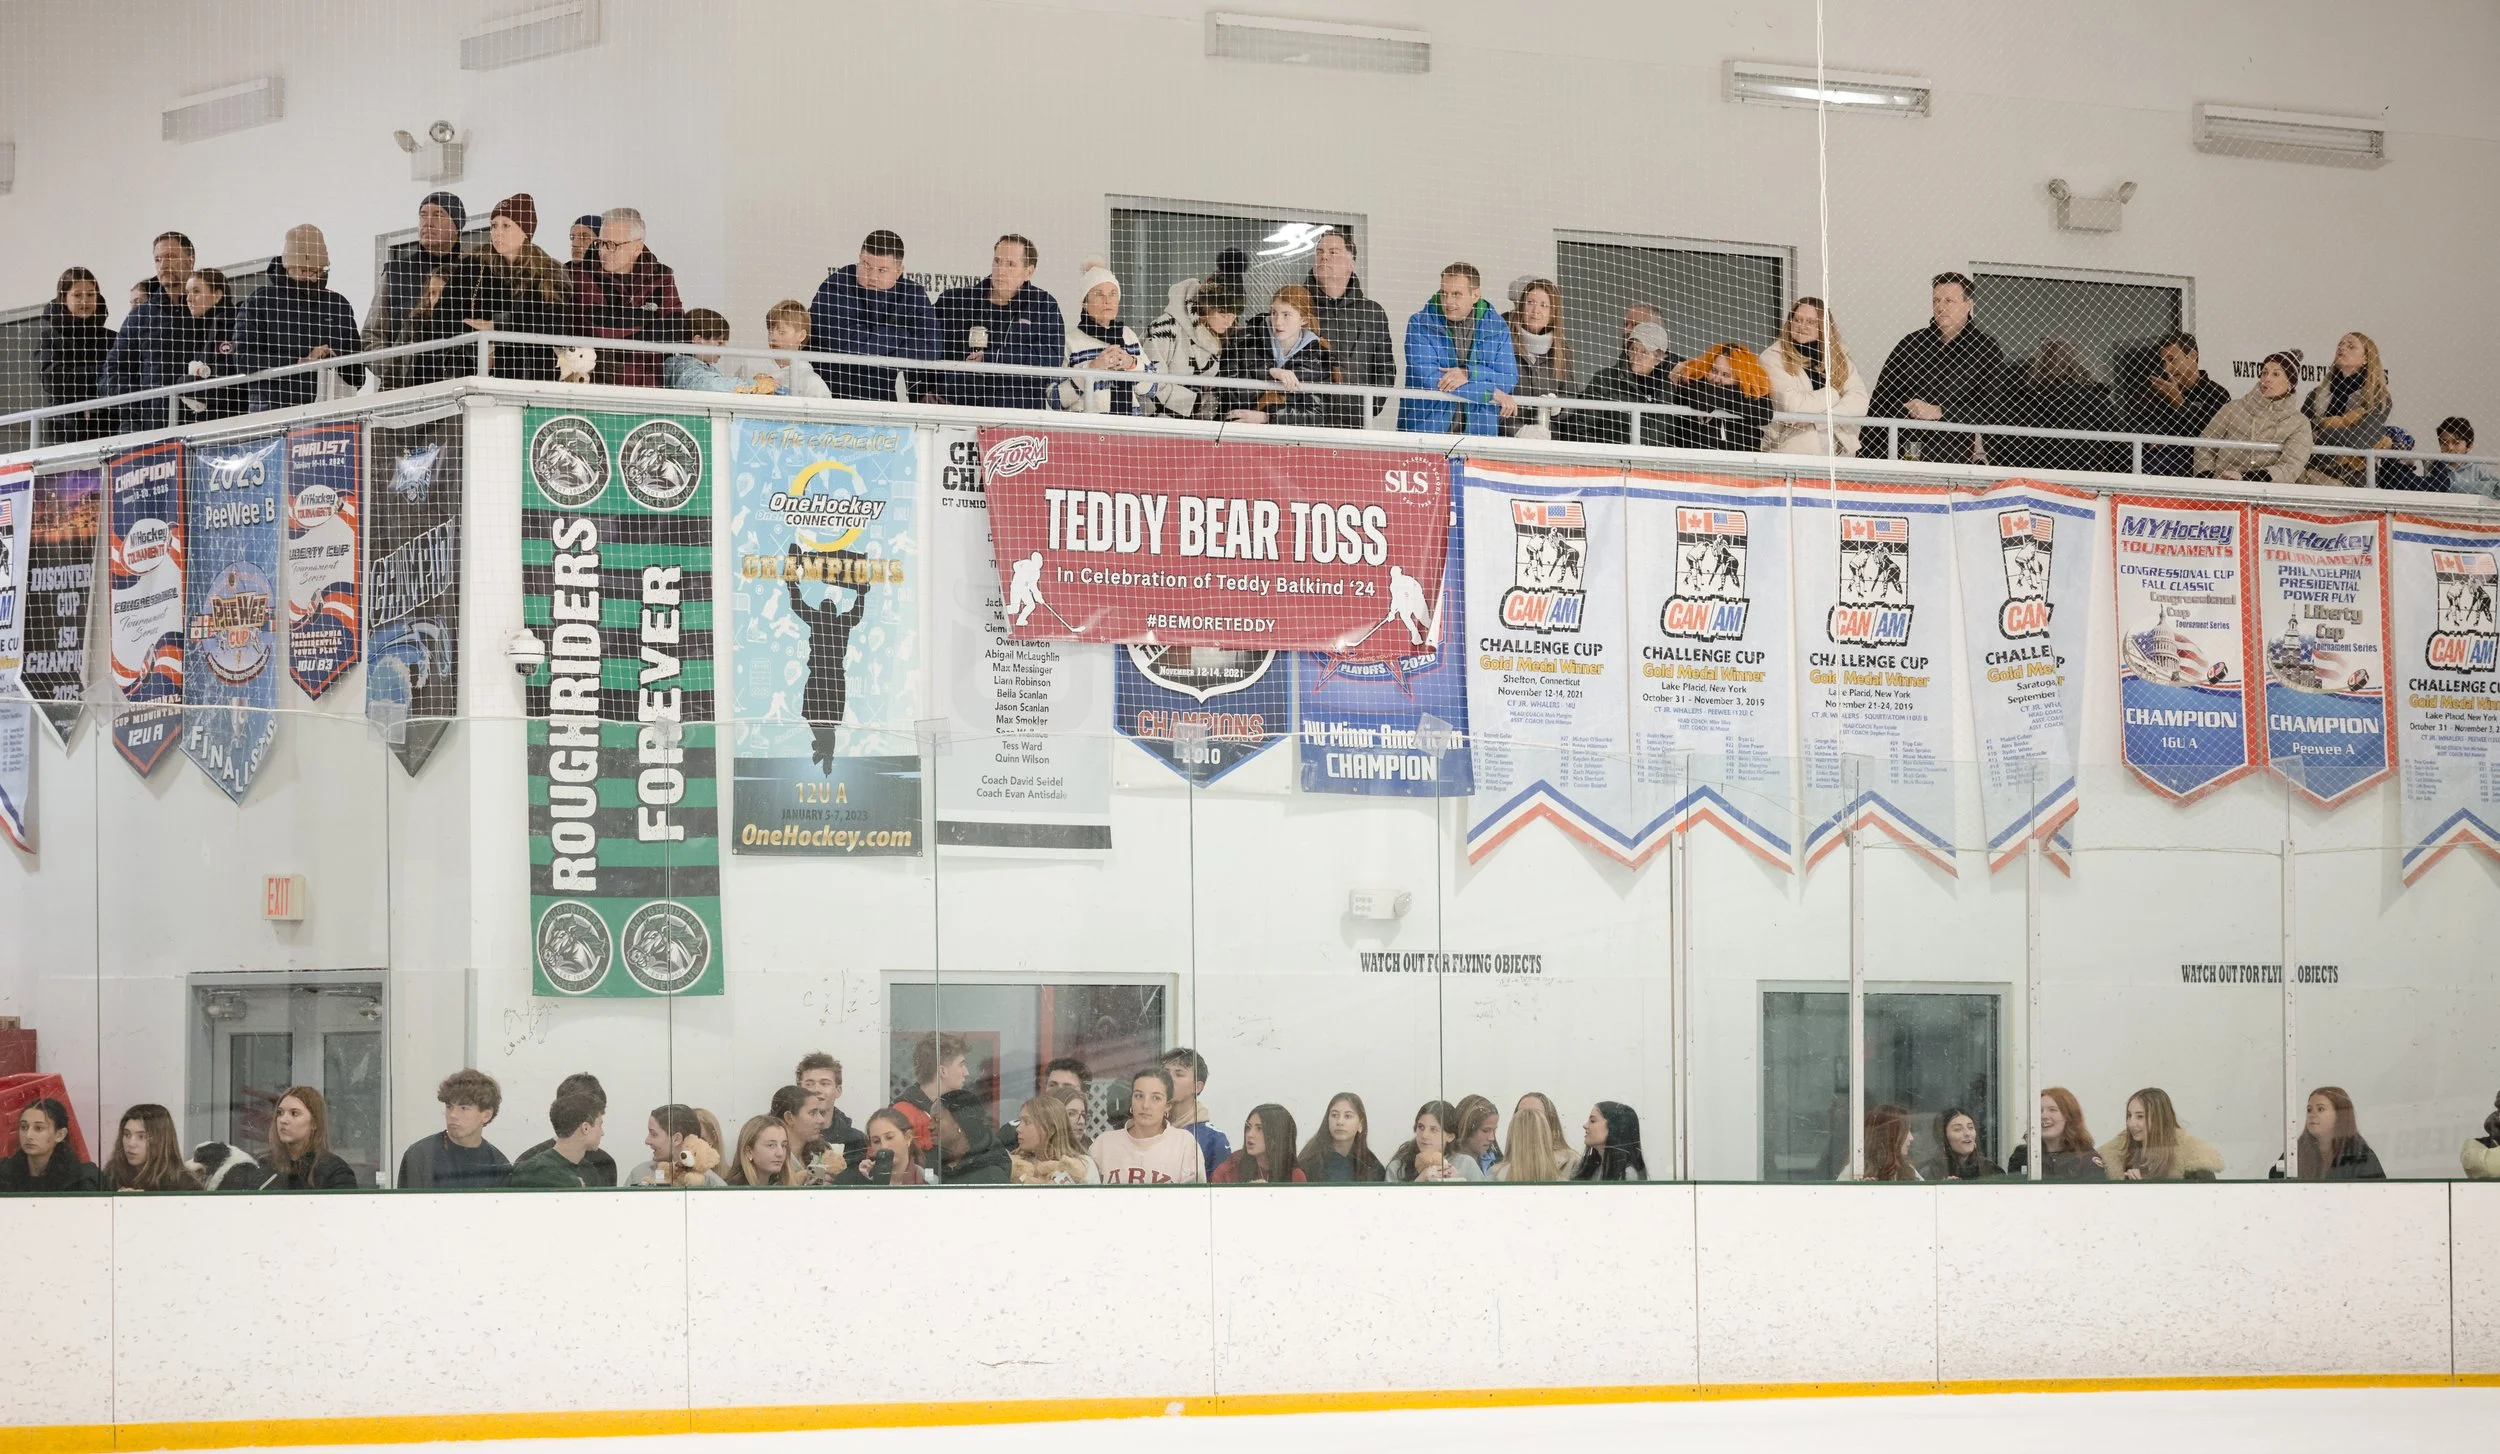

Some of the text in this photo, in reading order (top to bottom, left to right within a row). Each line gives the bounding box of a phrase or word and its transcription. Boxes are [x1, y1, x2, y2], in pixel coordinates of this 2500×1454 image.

[292, 440, 350, 458] FINALIST
[752, 429, 901, 452] LIVE EXPERIENCE!
[984, 436, 1047, 485] STORM
[115, 460, 176, 493] CHAMPION
[1385, 470, 1429, 494] SLS
[205, 497, 275, 530] PeeWee B
[769, 491, 886, 520] OneHockey
[785, 514, 869, 528] CONNECTICUT
[1045, 488, 1388, 566] TEDDY BEAR TOSS
[2121, 516, 2234, 545] MYHockey
[2264, 525, 2375, 555] MYHockey
[289, 543, 350, 561] LIBERTY CUP
[2121, 540, 2234, 558] TOURNAMENTS
[2264, 549, 2374, 566] TOURNAMENTS
[742, 555, 904, 584] CHAMPIONS
[2120, 565, 2235, 579] CONGRESSIONAL CUP
[2278, 565, 2361, 579] PHILADELPHIA
[1057, 566, 1344, 596] In Celebration of Teddy Balkind
[2142, 579, 2215, 591] FALL CLASSIC
[2279, 578, 2360, 591] PRESIDENTIAL
[57, 592, 80, 617] CUP
[2150, 591, 2237, 605] Congressional
[2284, 590, 2357, 603] POWER PLAY
[2166, 607, 2191, 619] Cup
[2304, 604, 2363, 625] Liberty
[1146, 613, 1276, 633] #BEMORETEDDY
[2175, 619, 2230, 630] Tournament Series
[57, 627, 77, 649] 150
[228, 629, 249, 648] CUP
[291, 629, 343, 640] PHILADELPHIA
[2316, 623, 2346, 642] Cup
[291, 639, 343, 649] PRESIDENTIAL
[995, 636, 1051, 648] Owen Lawton
[1480, 637, 1603, 656] CHALLENGE CUP
[2313, 641, 2378, 652] Tournament Series
[294, 646, 338, 657] POWER PLAY
[984, 650, 1060, 662] Abigail McLaughlin
[1643, 646, 1765, 665] CHALLENGE CUP
[992, 663, 1053, 676] Max Messinger
[1340, 662, 1387, 675] PLAYOFFS
[1402, 653, 1436, 671] 2020
[1480, 655, 1604, 675] Gold Medal Winner
[1901, 656, 1929, 670] CUP
[994, 676, 1051, 687] Liam Robinson
[1503, 674, 1580, 686] Shelton, Connecticut
[1643, 663, 1766, 683] Gold Medal Winner
[1844, 671, 1930, 688] Medal Winner
[1987, 666, 2023, 683] Gold
[53, 684, 79, 700] 2025
[1498, 687, 1583, 699] November 2021
[1661, 682, 1747, 694] Lake Placid, New York
[1850, 688, 1911, 699] Placid, New York
[2409, 678, 2486, 693] CHALLENGE
[997, 689, 1048, 700] Bella Scanlan
[1643, 693, 1765, 707] October 31 November 2019
[2008, 690, 2056, 704] September
[2409, 693, 2474, 710] Gold Medal
[550, 517, 600, 891] ROUGHRIDERS
[637, 566, 685, 842] FOREVER
[995, 702, 1050, 713] Jason Scanlan
[1895, 702, 1913, 711] 2019
[132, 707, 182, 725] MIDWINTER
[996, 715, 1048, 726] Max Smokler
[2125, 707, 2237, 729] CHAMPION
[2270, 713, 2379, 734] CHAMPION
[2425, 711, 2498, 722] Lake New York
[1138, 710, 1264, 742] CHAMPIONS
[2410, 722, 2488, 734] October November
[128, 723, 164, 747] 12U A
[1330, 721, 1376, 749] Minor
[2161, 736, 2198, 749] 16U A
[1002, 741, 1043, 751] Tess Ward
[2292, 742, 2355, 756] Peewee A
[190, 719, 275, 793] FINALISTS
[995, 753, 1050, 765] Quinn Wilson
[1326, 753, 1437, 781] CHAMPION
[981, 775, 1064, 787] Coach David Seidel
[795, 782, 848, 804] 12U A
[976, 788, 1025, 798] Coach Evan
[781, 809, 868, 823] JANUARY 5-7, 2023
[741, 823, 912, 852] OneHockey.com
[268, 877, 290, 916] EXIT
[542, 904, 602, 931] ROUGHRIDERS
[630, 904, 700, 931] ROUGHRIDERS
[1360, 952, 1542, 974] WATCH OUT FOR FLYING OBJECTS
[2181, 964, 2339, 983] WATCH OUT FOR FLYI OBJECTS
